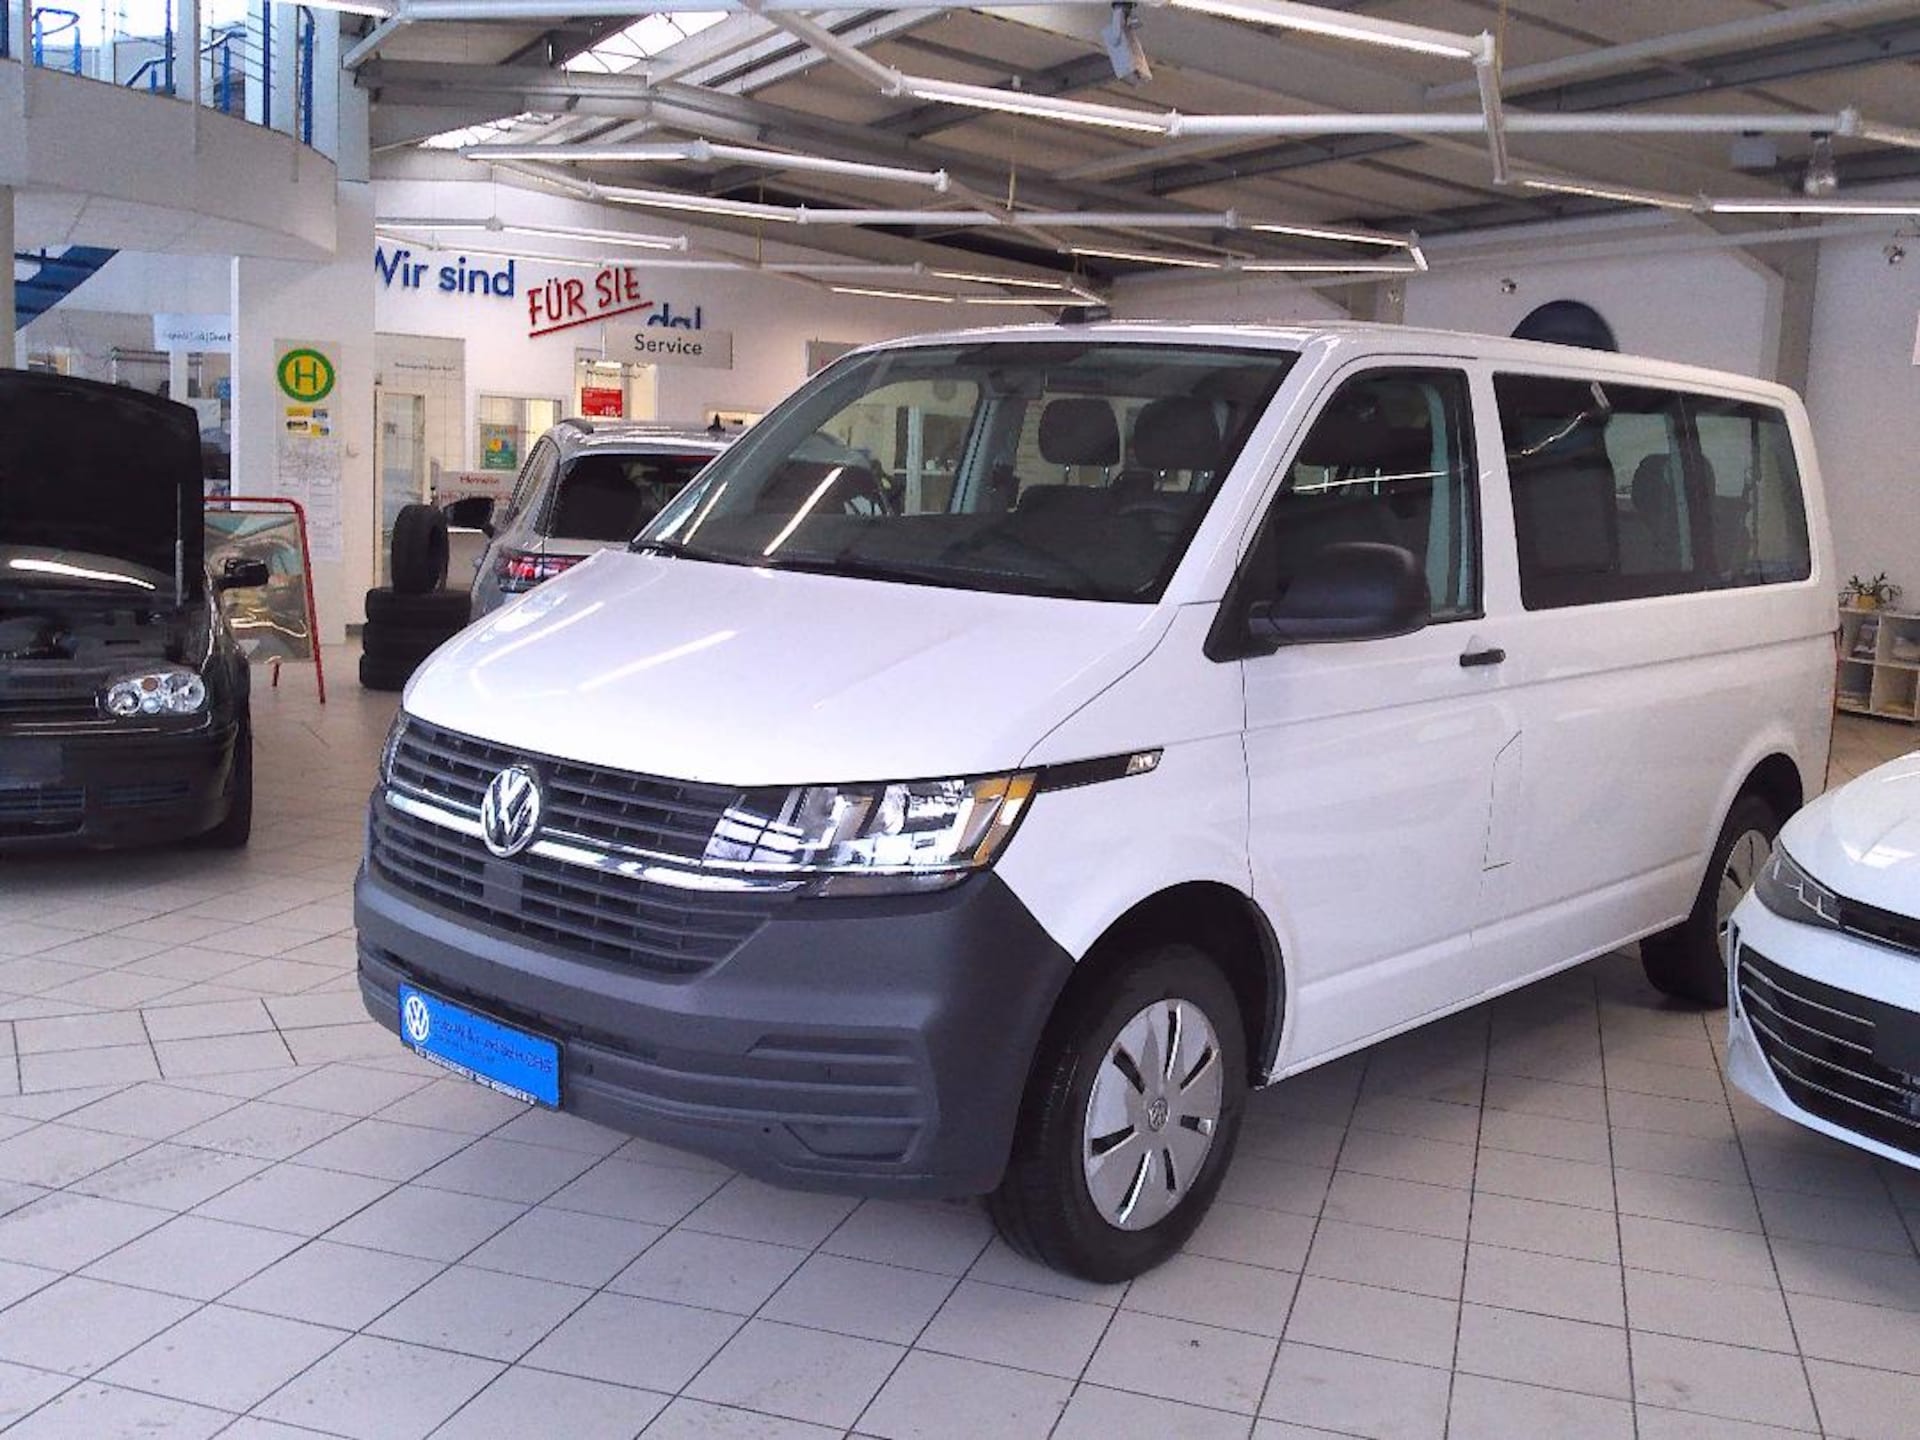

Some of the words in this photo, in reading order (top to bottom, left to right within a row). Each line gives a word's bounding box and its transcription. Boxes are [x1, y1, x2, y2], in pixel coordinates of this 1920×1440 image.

[438, 256, 514, 297] sind
[527, 278, 587, 326] FÜR
[595, 266, 641, 308] SIE
[634, 332, 702, 356] Service
[294, 359, 317, 391] H
